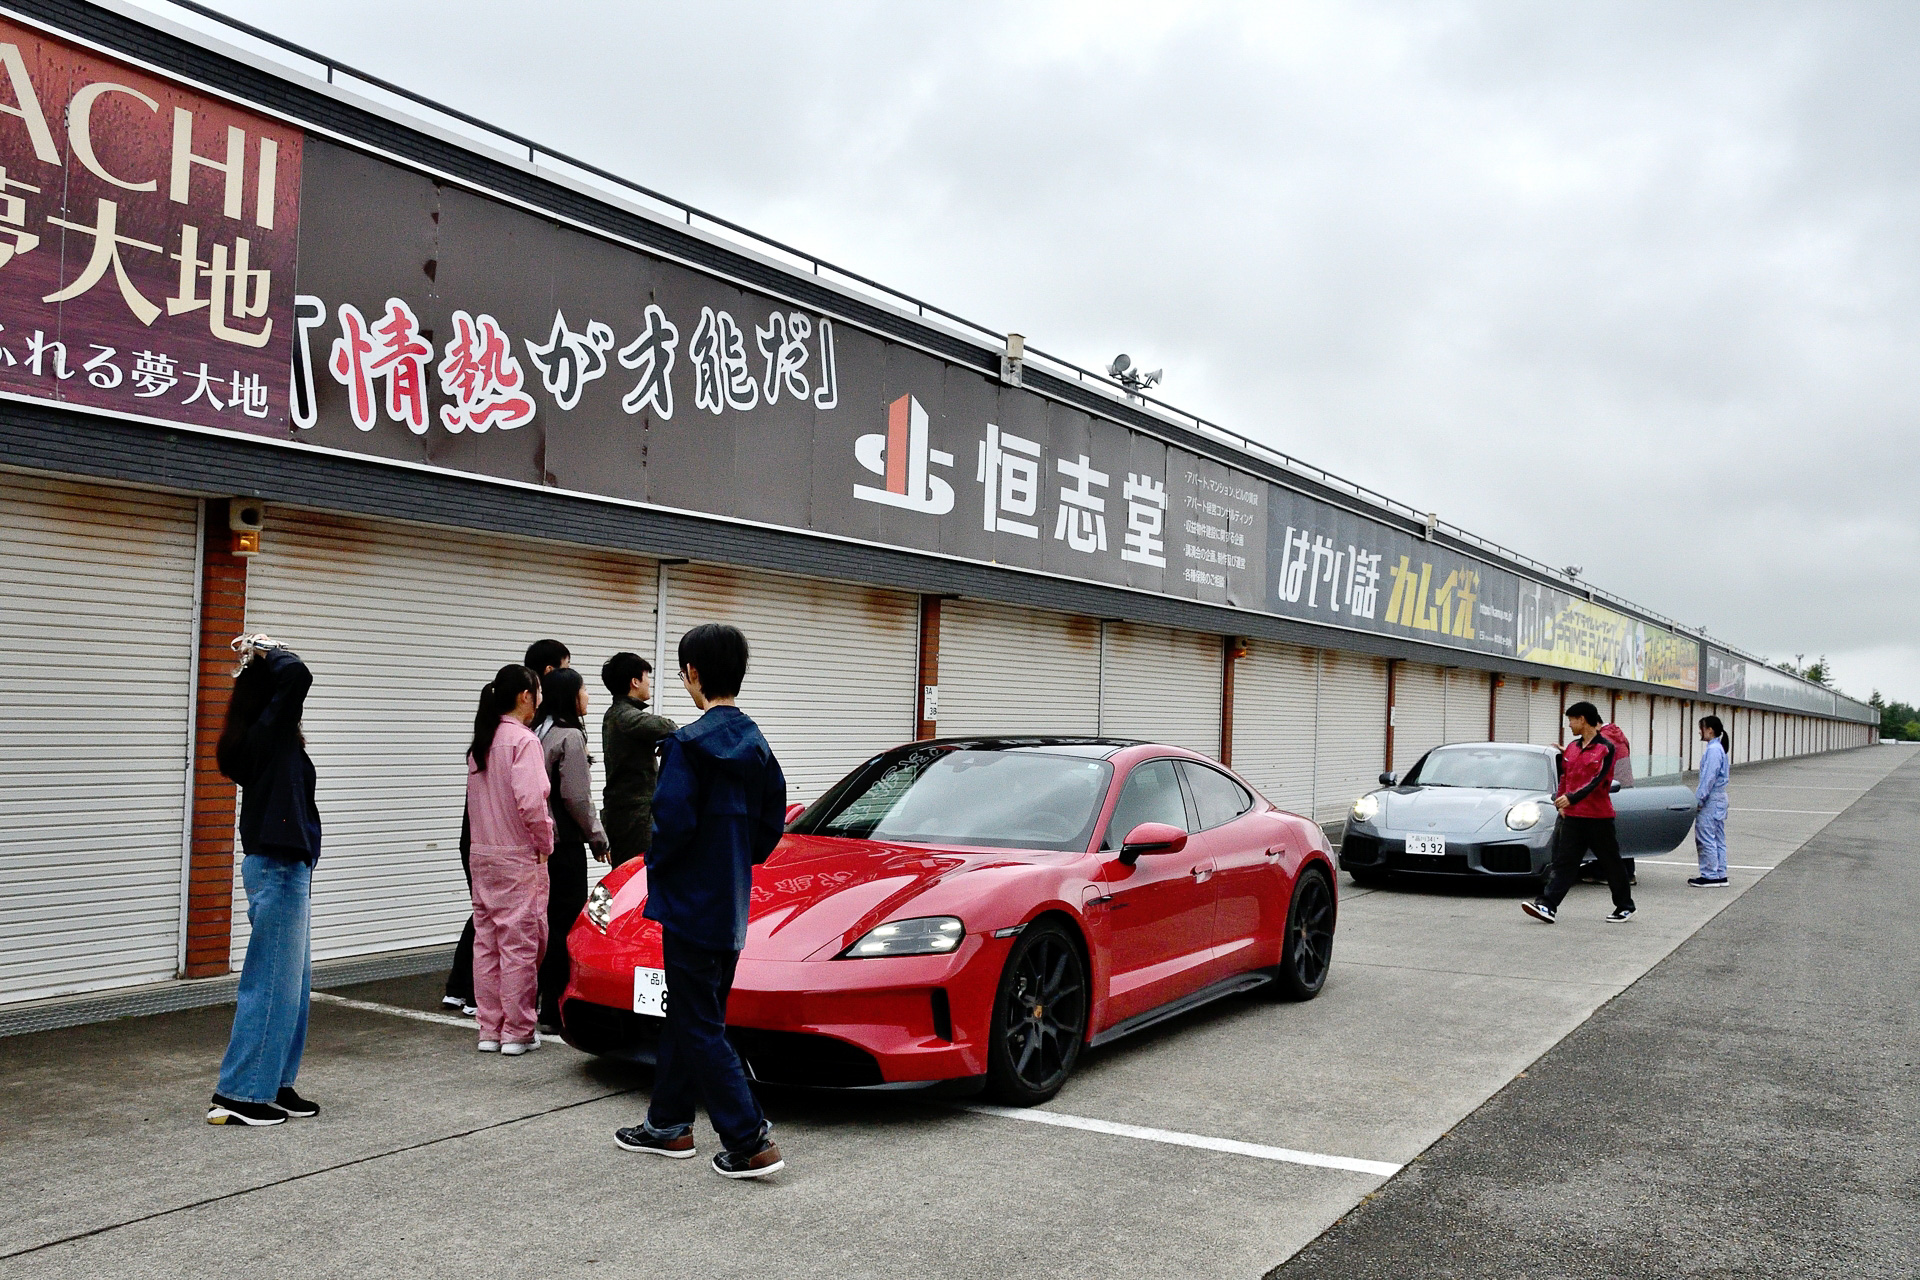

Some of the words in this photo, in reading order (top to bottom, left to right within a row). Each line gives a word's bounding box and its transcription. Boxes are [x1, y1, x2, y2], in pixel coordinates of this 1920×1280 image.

[976, 423, 1168, 569] 恒志堂
[1279, 526, 1382, 620] はやい話
